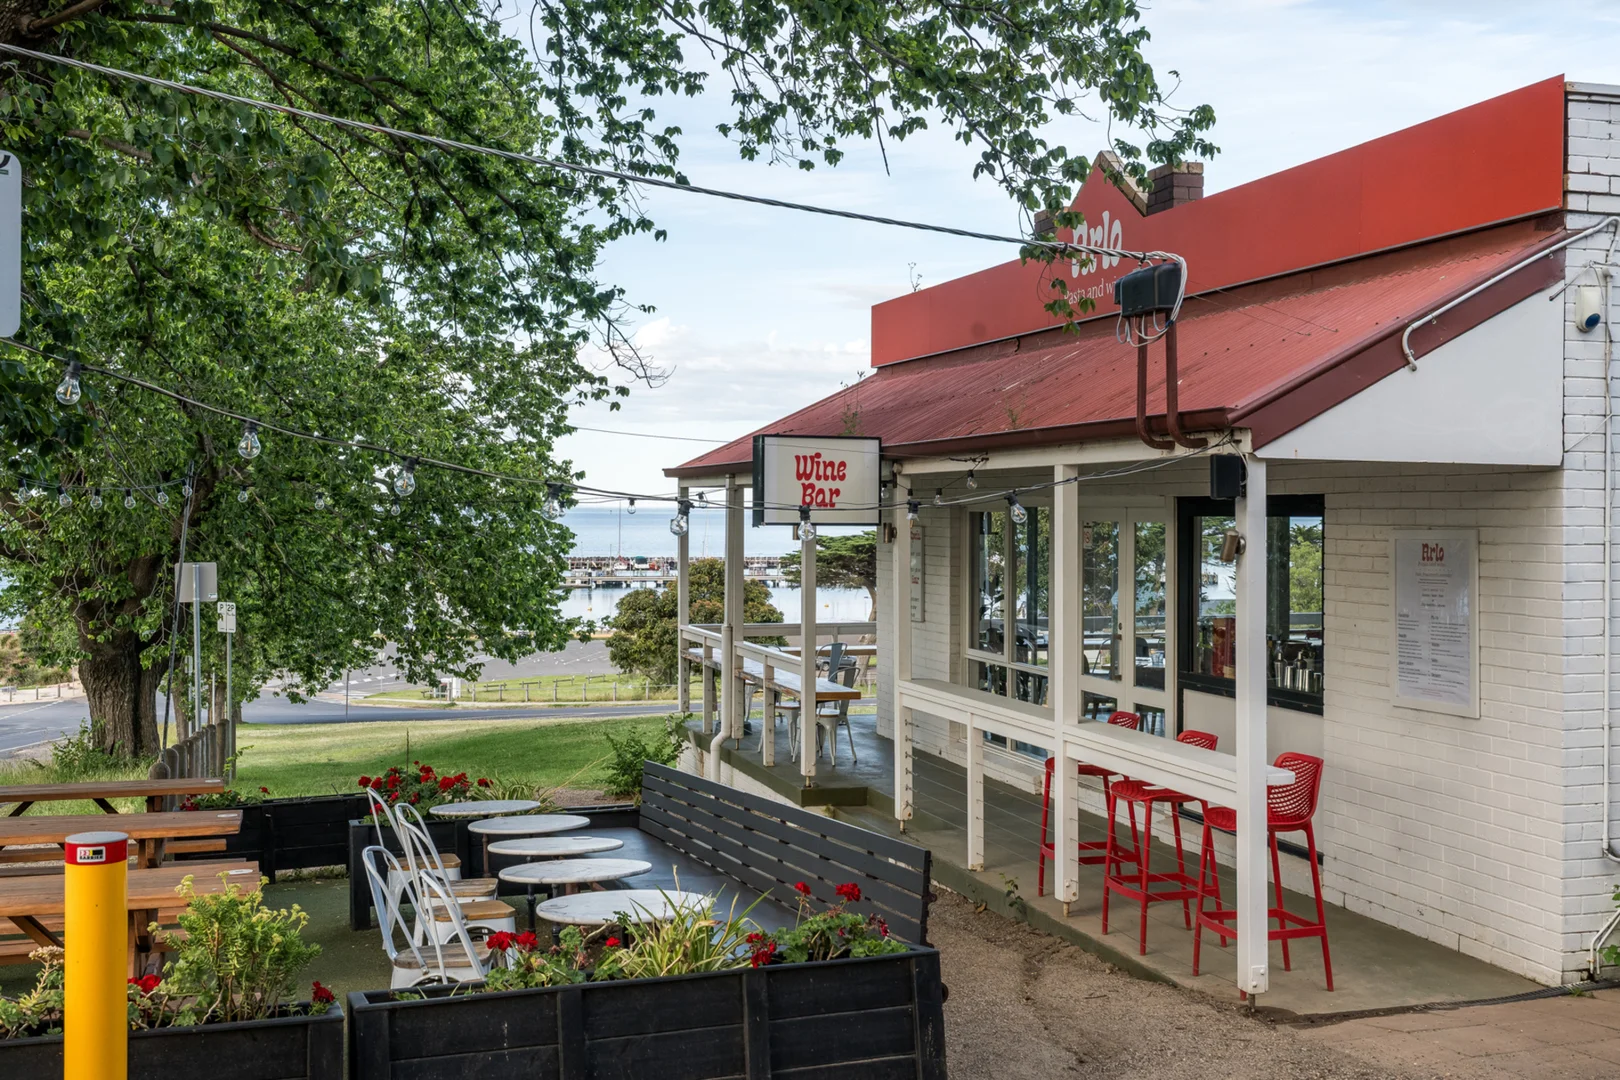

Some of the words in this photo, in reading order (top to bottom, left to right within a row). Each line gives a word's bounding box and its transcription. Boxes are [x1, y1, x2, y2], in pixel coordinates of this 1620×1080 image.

[1086, 278, 1105, 299] and
[794, 452, 846, 481] Wine
[801, 482, 841, 508] Bar
[1421, 543, 1445, 562] Arlo
